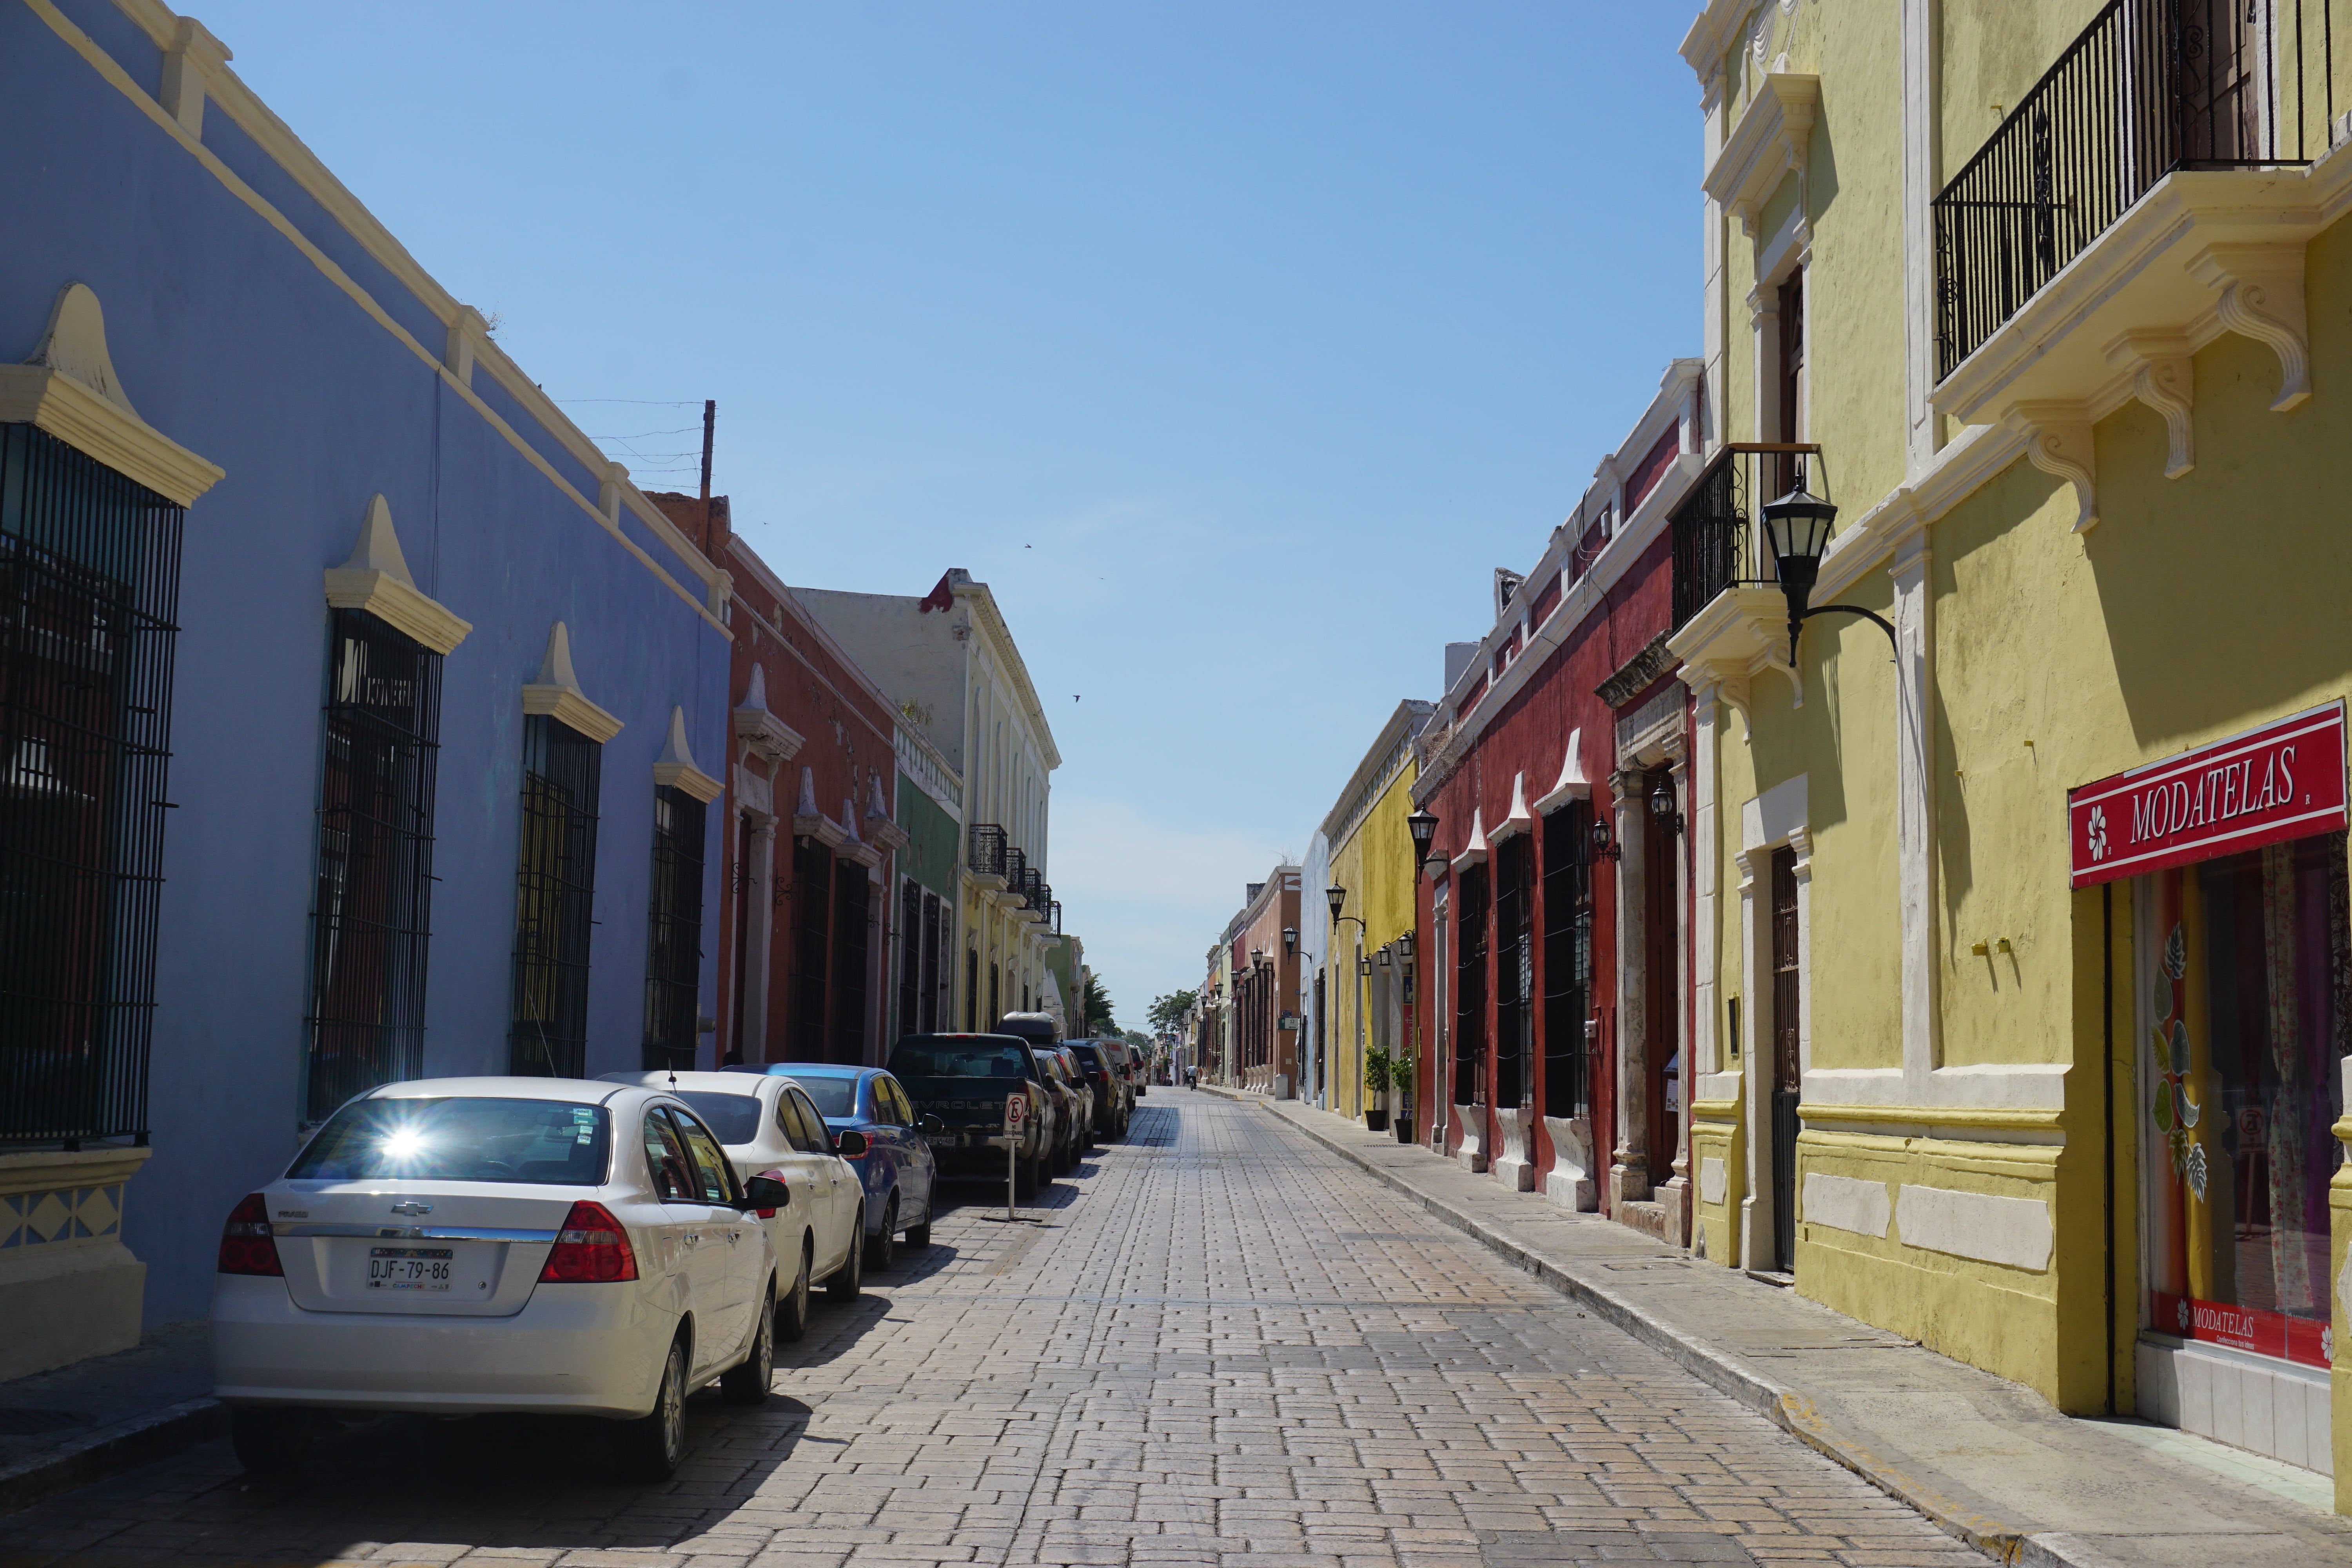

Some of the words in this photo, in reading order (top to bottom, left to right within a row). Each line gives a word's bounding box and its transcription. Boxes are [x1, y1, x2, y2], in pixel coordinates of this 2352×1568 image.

[2130, 744, 2295, 844] MODATELAS
[910, 1100, 1006, 1110] EVROLET
[371, 1260, 449, 1279] DJF-79-86
[2192, 1306, 2254, 1338] MODATELAS
[2216, 1335, 2238, 1347] Confecciona
[2245, 1340, 2254, 1350] ideas
